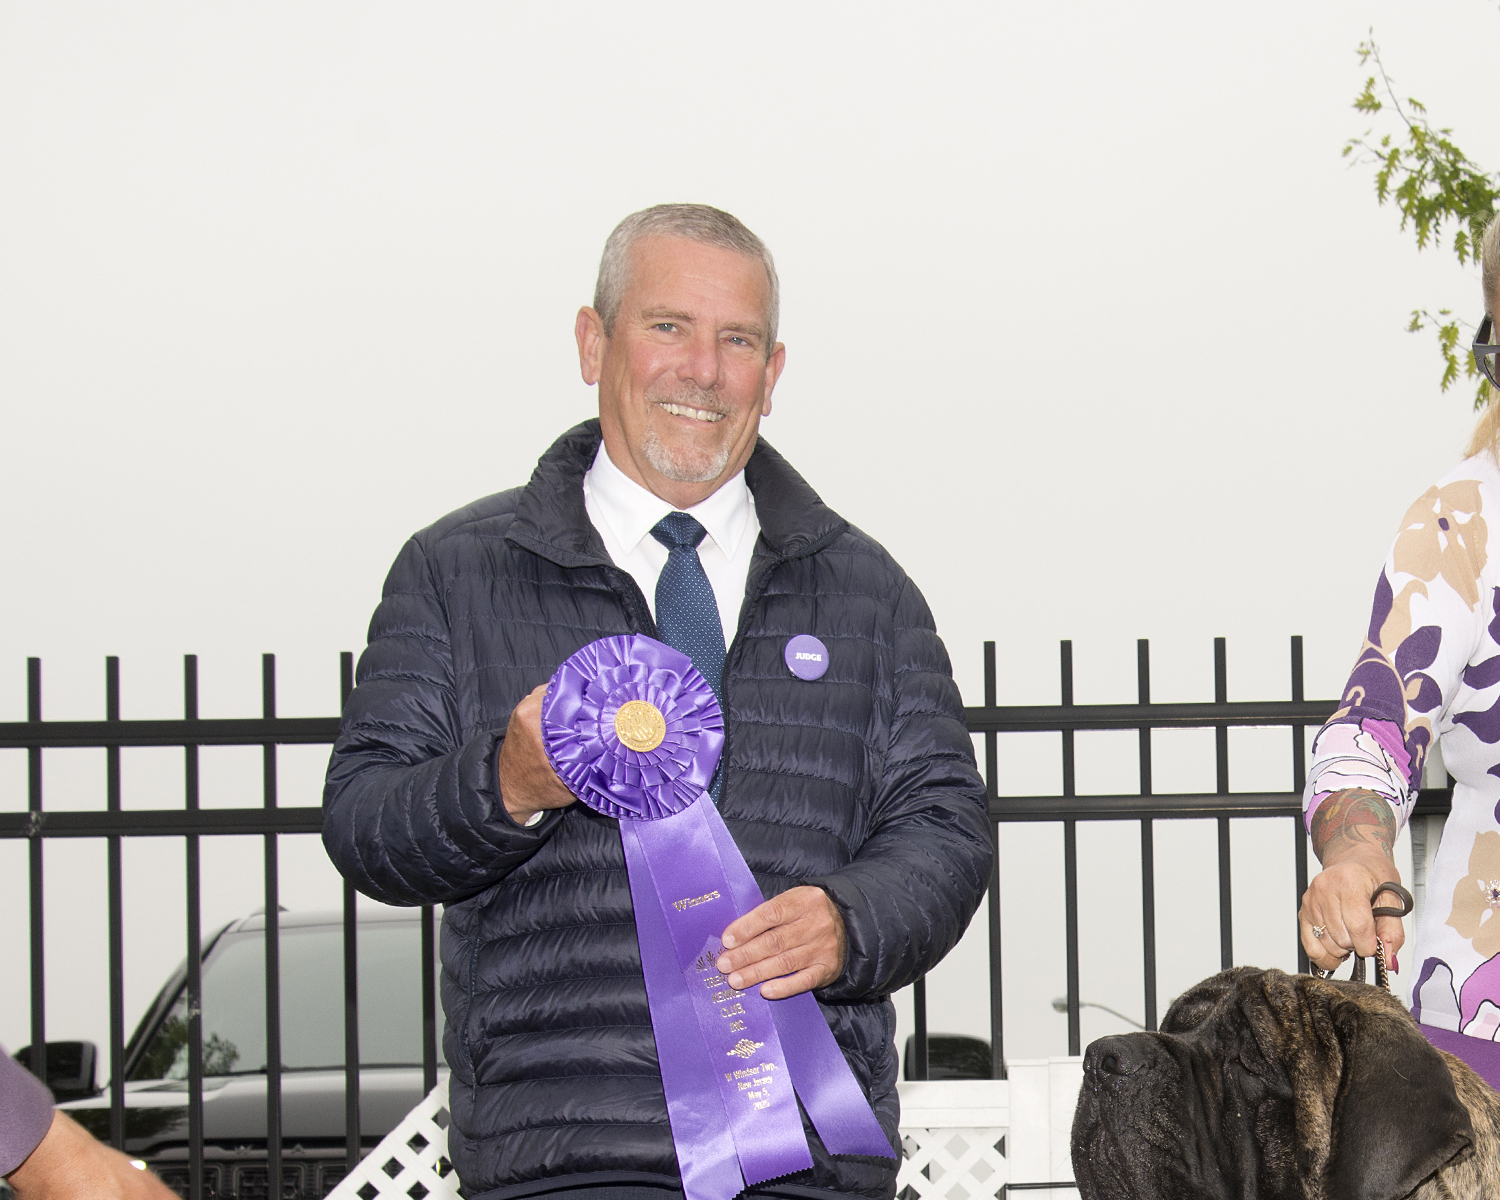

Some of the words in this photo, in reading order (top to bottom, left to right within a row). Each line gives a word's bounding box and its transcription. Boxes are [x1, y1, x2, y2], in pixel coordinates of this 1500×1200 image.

[795, 652, 822, 662] JUDGE
[672, 889, 721, 912] Winners
[721, 1002, 746, 1018] CLUB,
[729, 1019, 747, 1033] INC.
[724, 1072, 733, 1082] W
[733, 1066, 760, 1080] Windsor
[737, 1081, 752, 1091] New
[753, 1075, 773, 1087] Jersey
[747, 1090, 762, 1101] May
[762, 1087, 771, 1097] 5,
